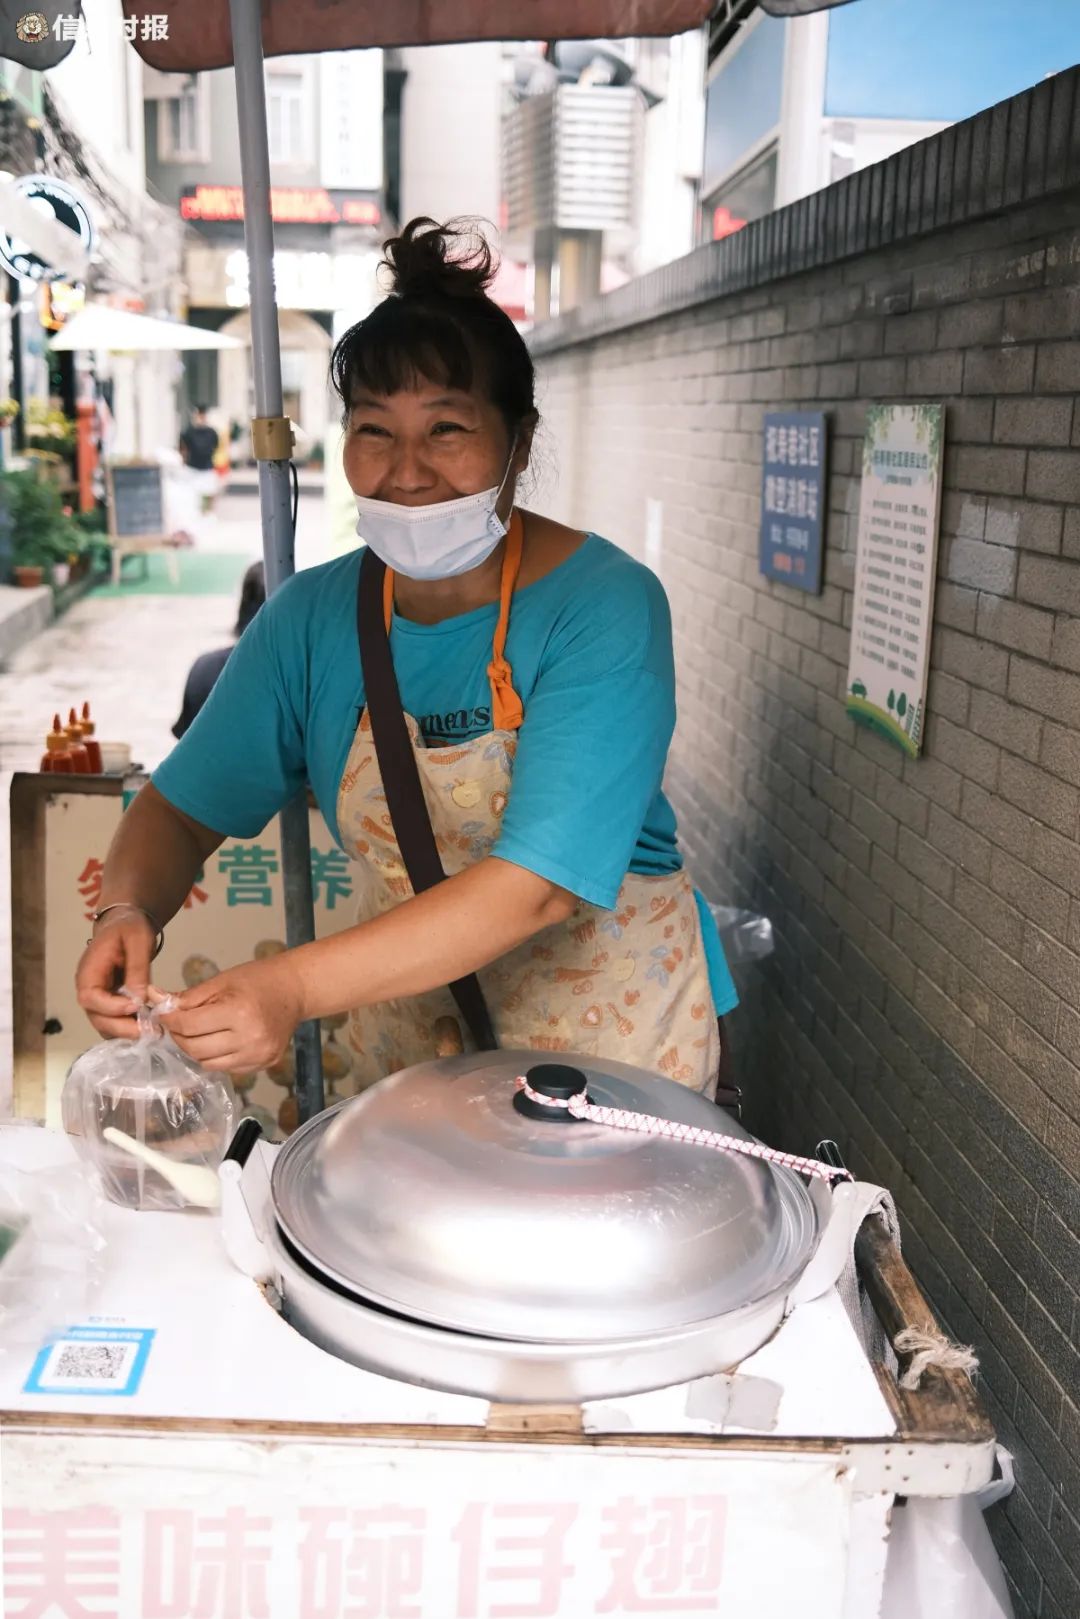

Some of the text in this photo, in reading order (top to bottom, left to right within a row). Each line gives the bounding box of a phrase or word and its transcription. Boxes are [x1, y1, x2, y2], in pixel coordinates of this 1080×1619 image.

[2, 1494, 729, 1619] 美味碗仔翅
